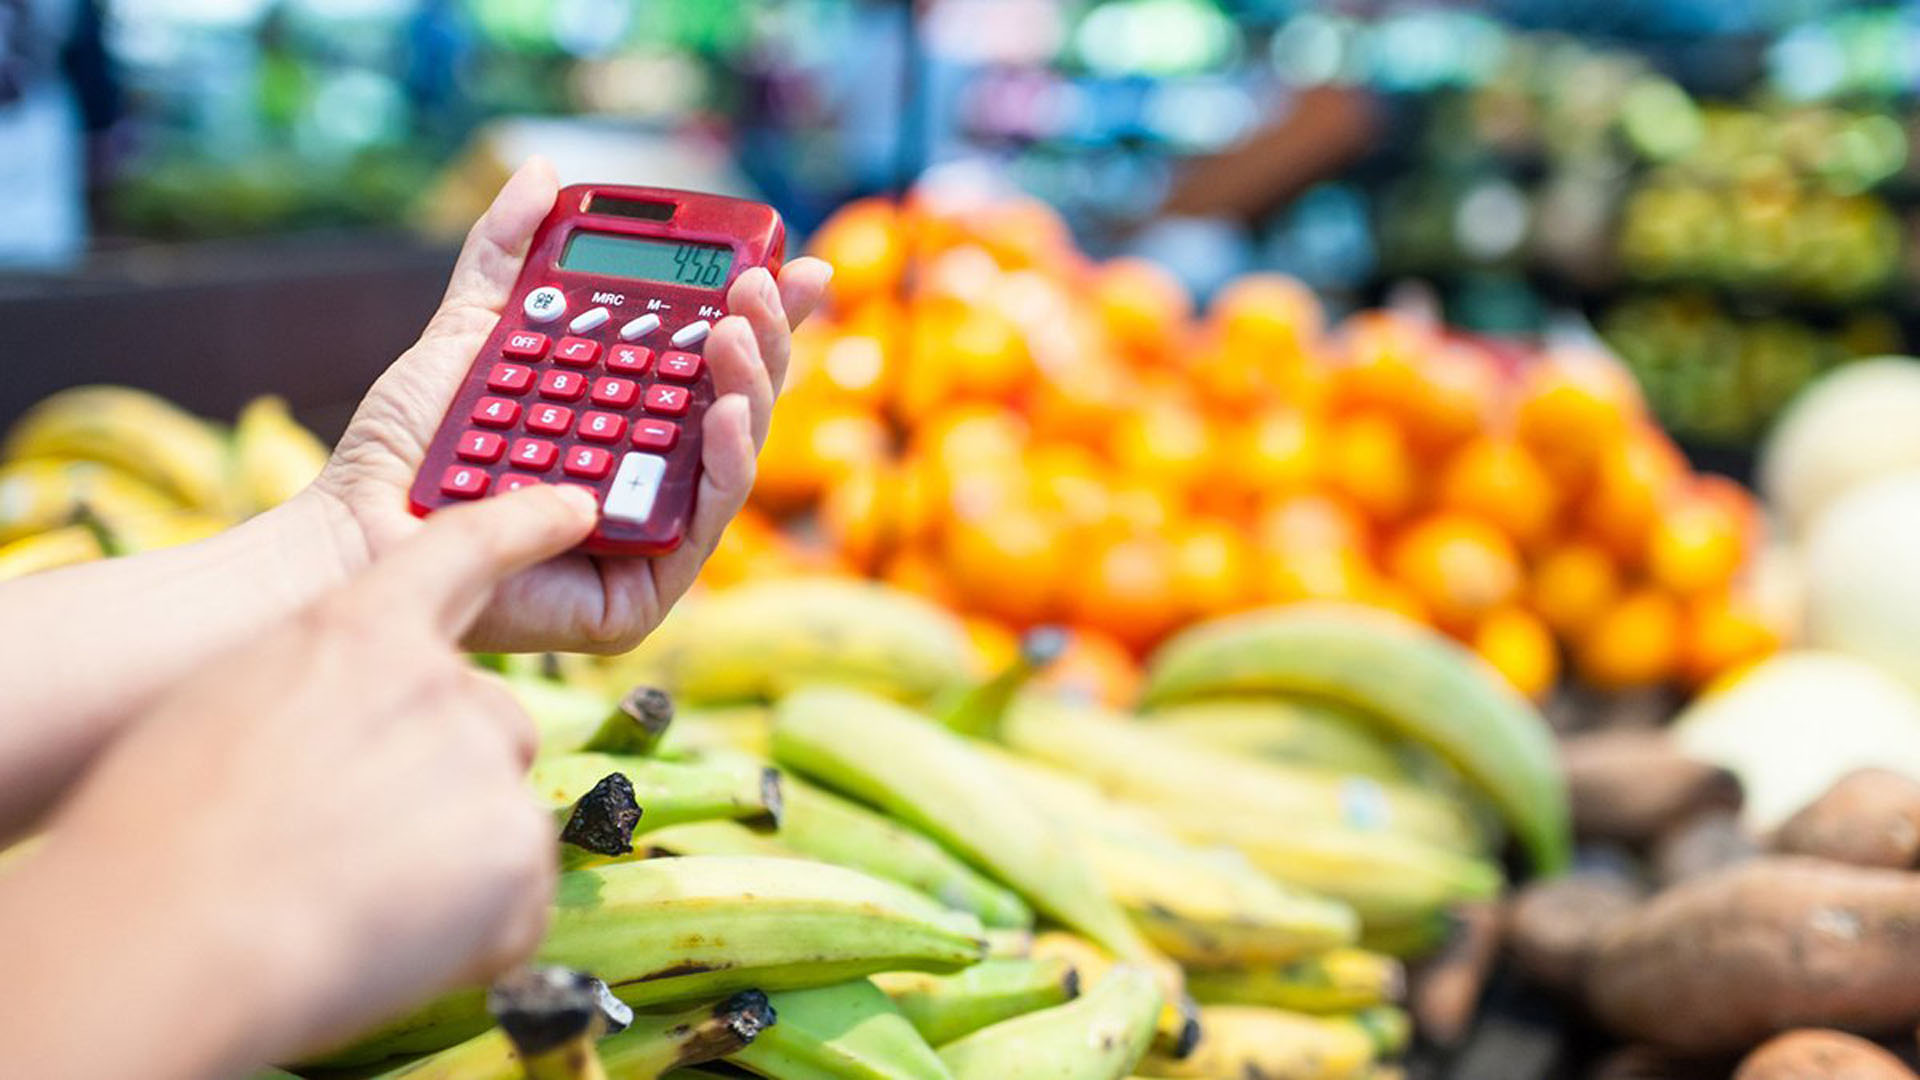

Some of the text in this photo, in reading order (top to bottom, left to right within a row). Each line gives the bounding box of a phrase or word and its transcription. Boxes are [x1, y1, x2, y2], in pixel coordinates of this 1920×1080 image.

[592, 291, 625, 306] MRC
[698, 305, 723, 319] M+
[511, 334, 537, 349] OFF
[503, 368, 514, 382] 7
[553, 375, 567, 389] 8
[605, 382, 619, 396] 9
[486, 402, 499, 417] 4
[541, 408, 556, 424] 5
[592, 416, 606, 431] 6
[473, 436, 484, 451] 1
[523, 444, 538, 459] 2
[577, 451, 592, 466] 3
[454, 471, 469, 486] 0
